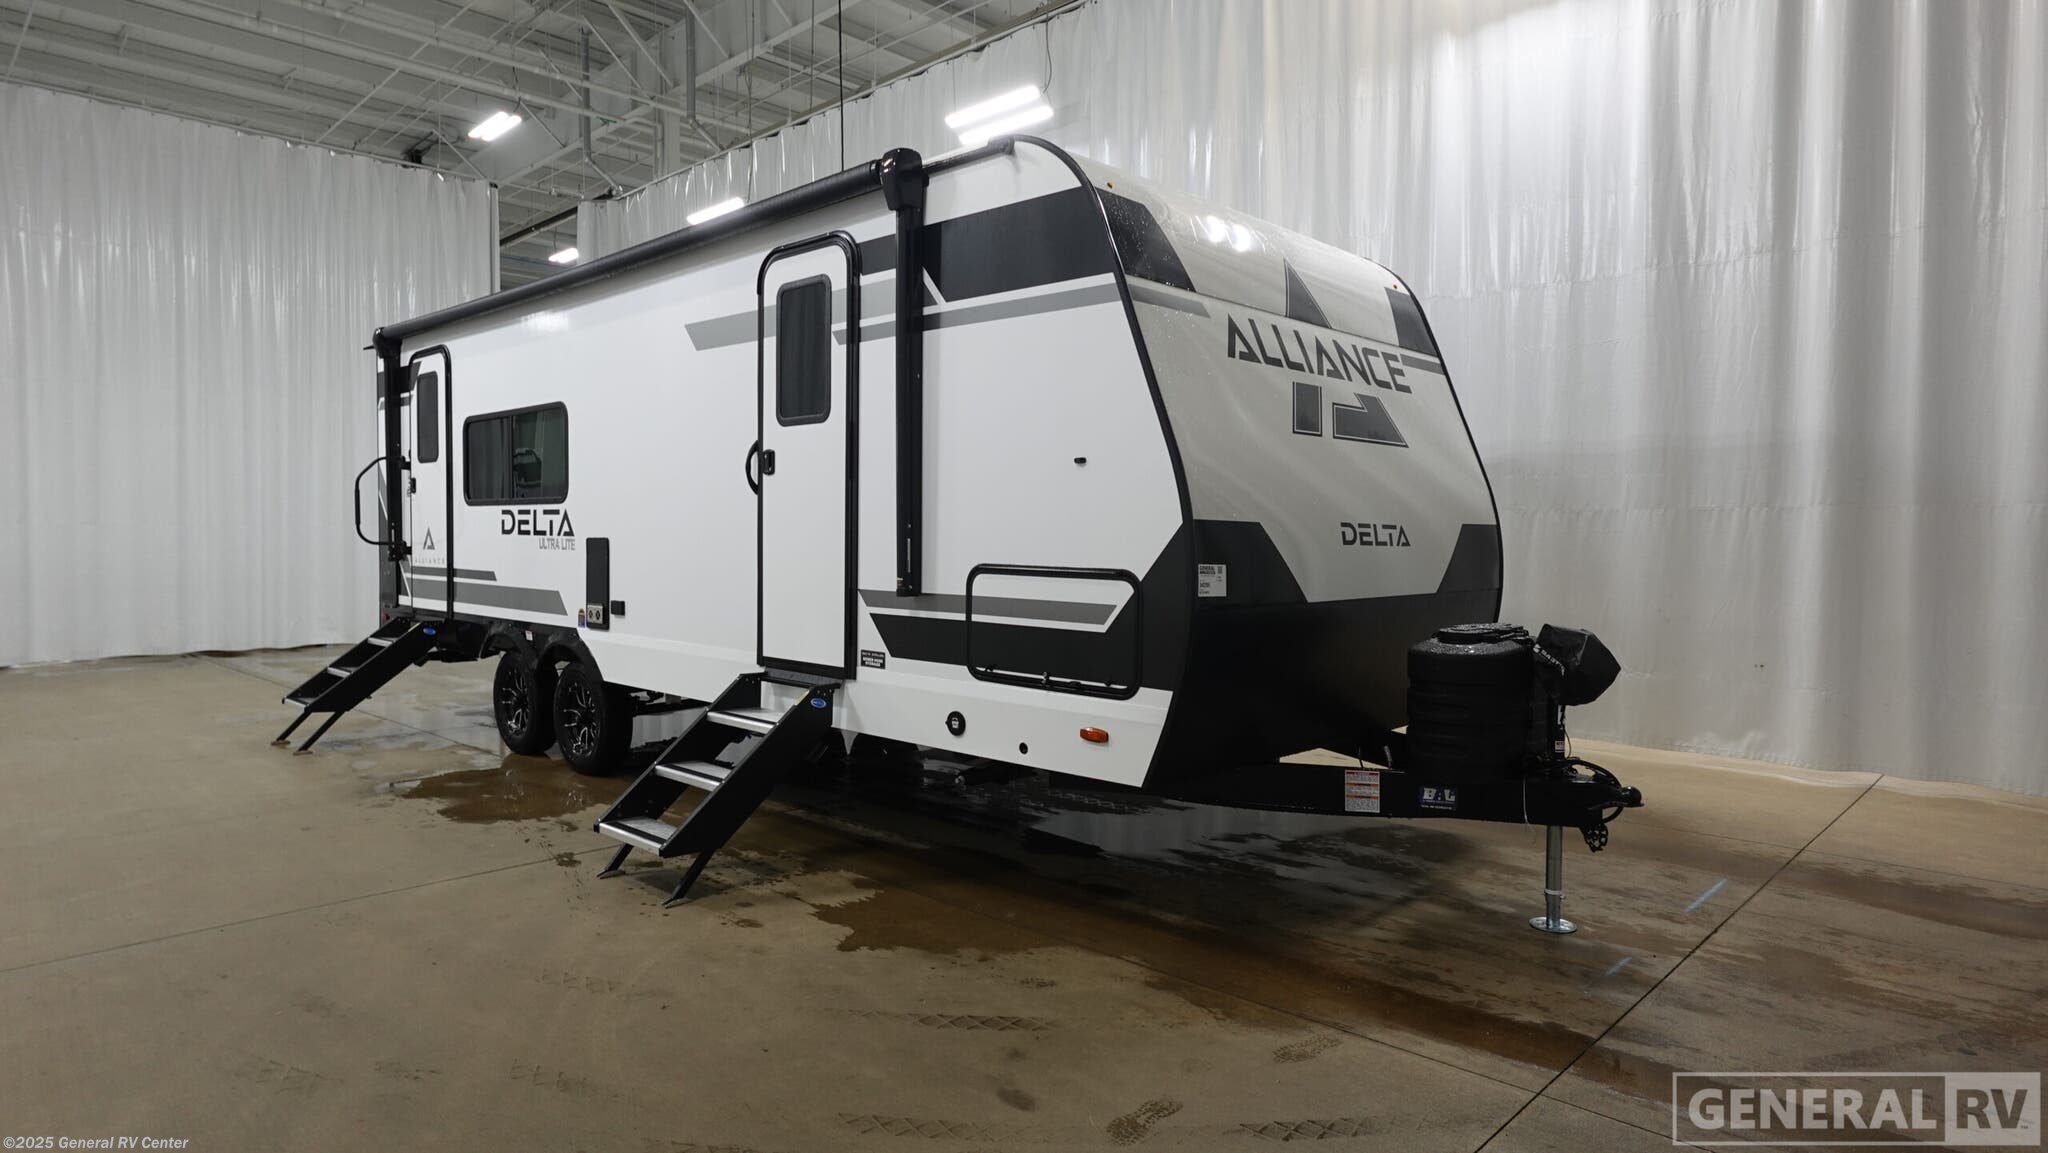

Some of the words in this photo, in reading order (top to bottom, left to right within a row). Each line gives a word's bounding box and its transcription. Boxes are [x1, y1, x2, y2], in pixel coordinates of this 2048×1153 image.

[1227, 313, 1412, 394] ALLIANCE
[501, 508, 575, 537] DELTA
[1340, 522, 1411, 547] DELTA
[539, 538, 560, 550] ULTRA
[561, 538, 576, 551] LITE
